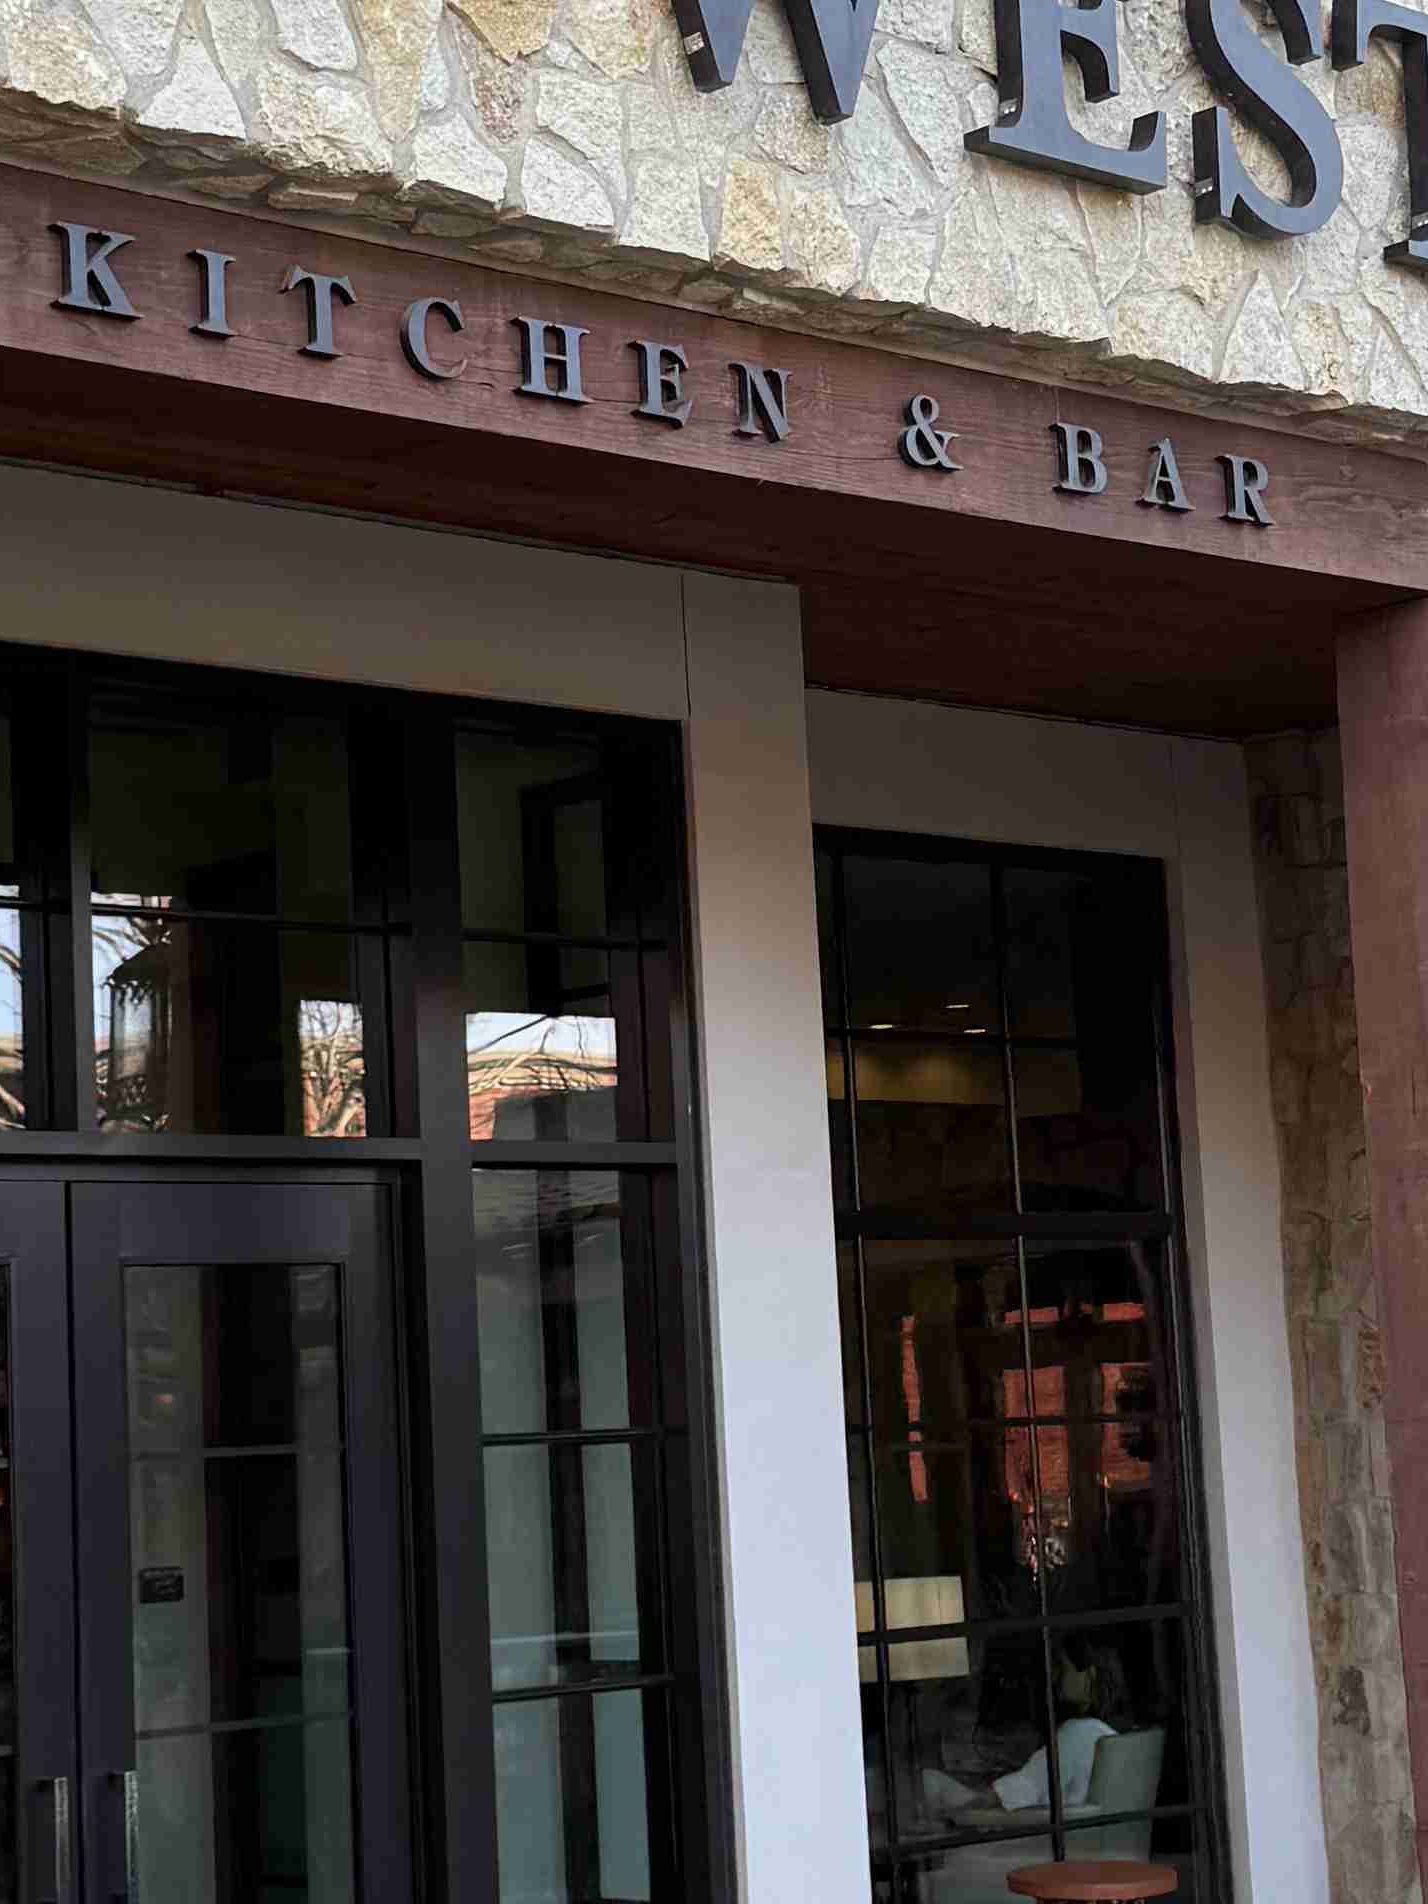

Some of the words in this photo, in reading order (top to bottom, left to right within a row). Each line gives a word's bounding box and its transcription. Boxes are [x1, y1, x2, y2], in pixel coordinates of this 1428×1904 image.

[51, 218, 795, 443] KITCHEN
[896, 392, 962, 473] &
[1050, 418, 1278, 529] BAR
